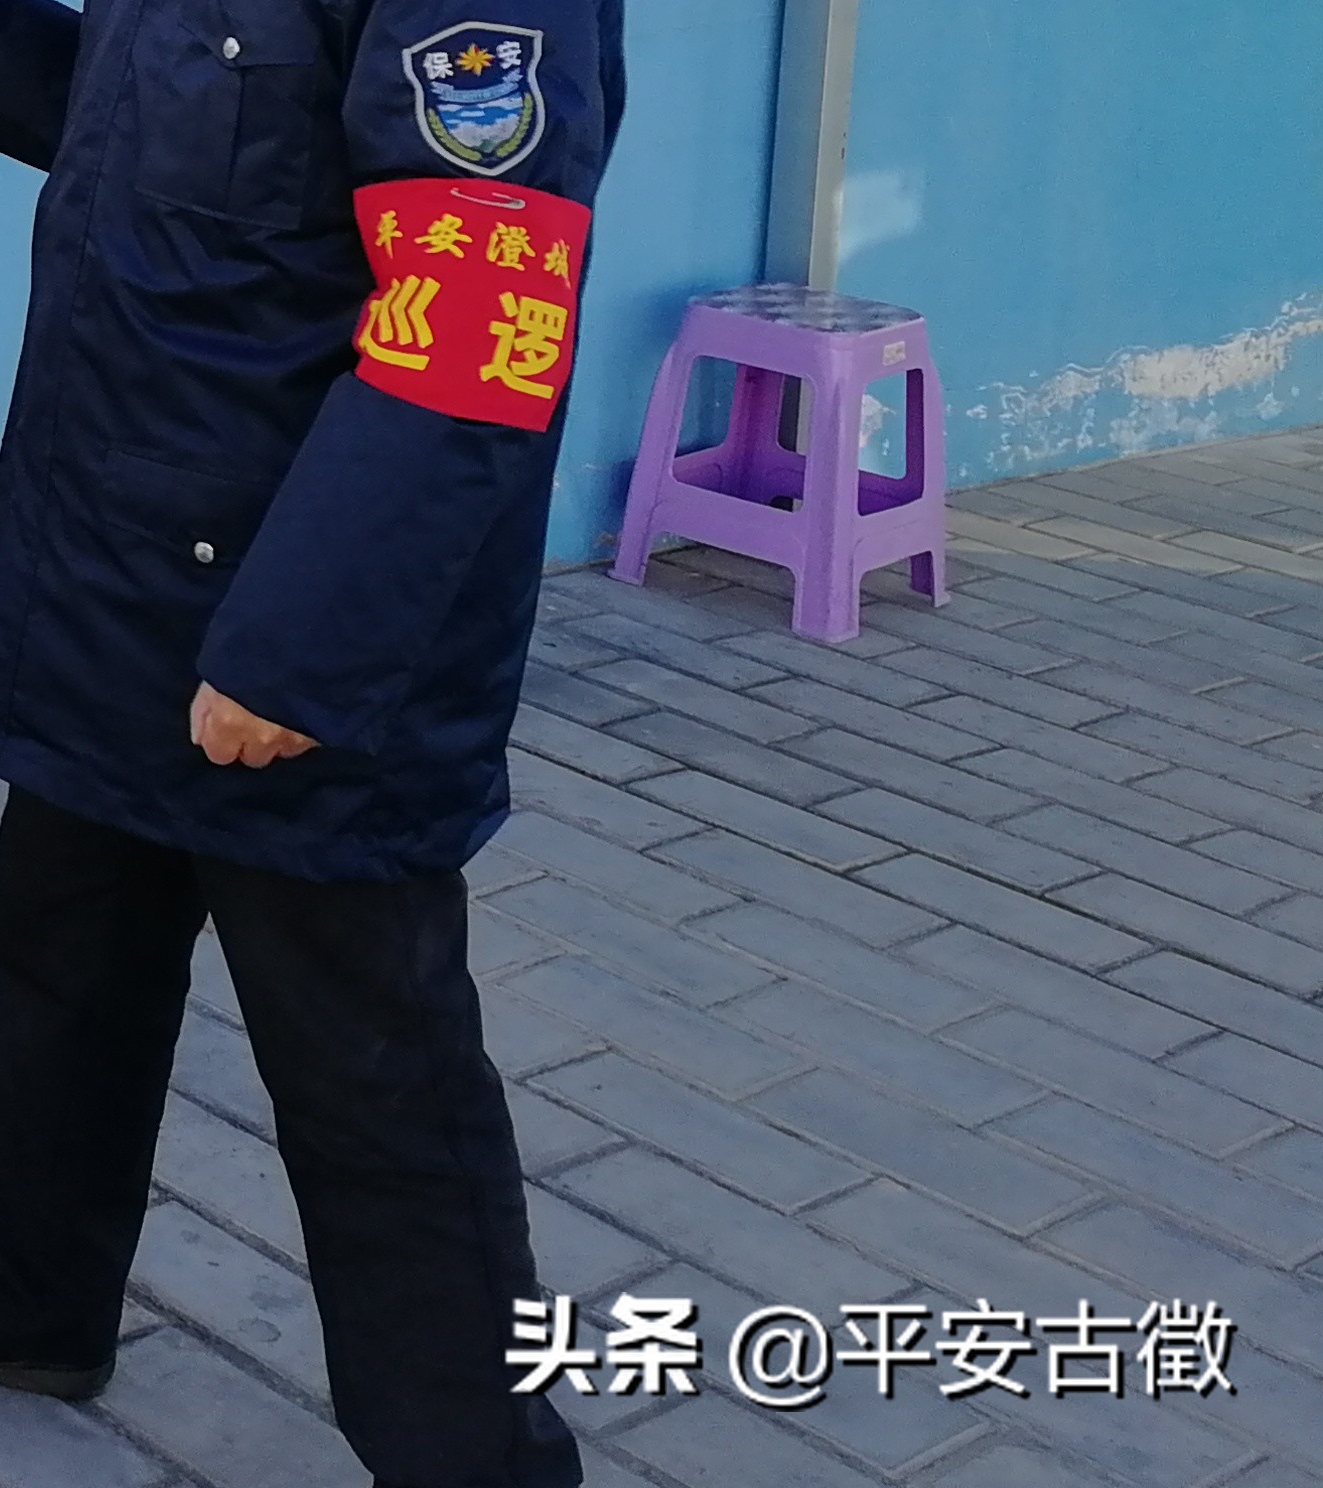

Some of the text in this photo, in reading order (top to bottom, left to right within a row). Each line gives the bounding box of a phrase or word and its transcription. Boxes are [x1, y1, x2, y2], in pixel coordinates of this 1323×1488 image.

[422, 41, 523, 80] 保安
[374, 209, 573, 290] 平安澄城
[357, 274, 569, 401] 巡逻
